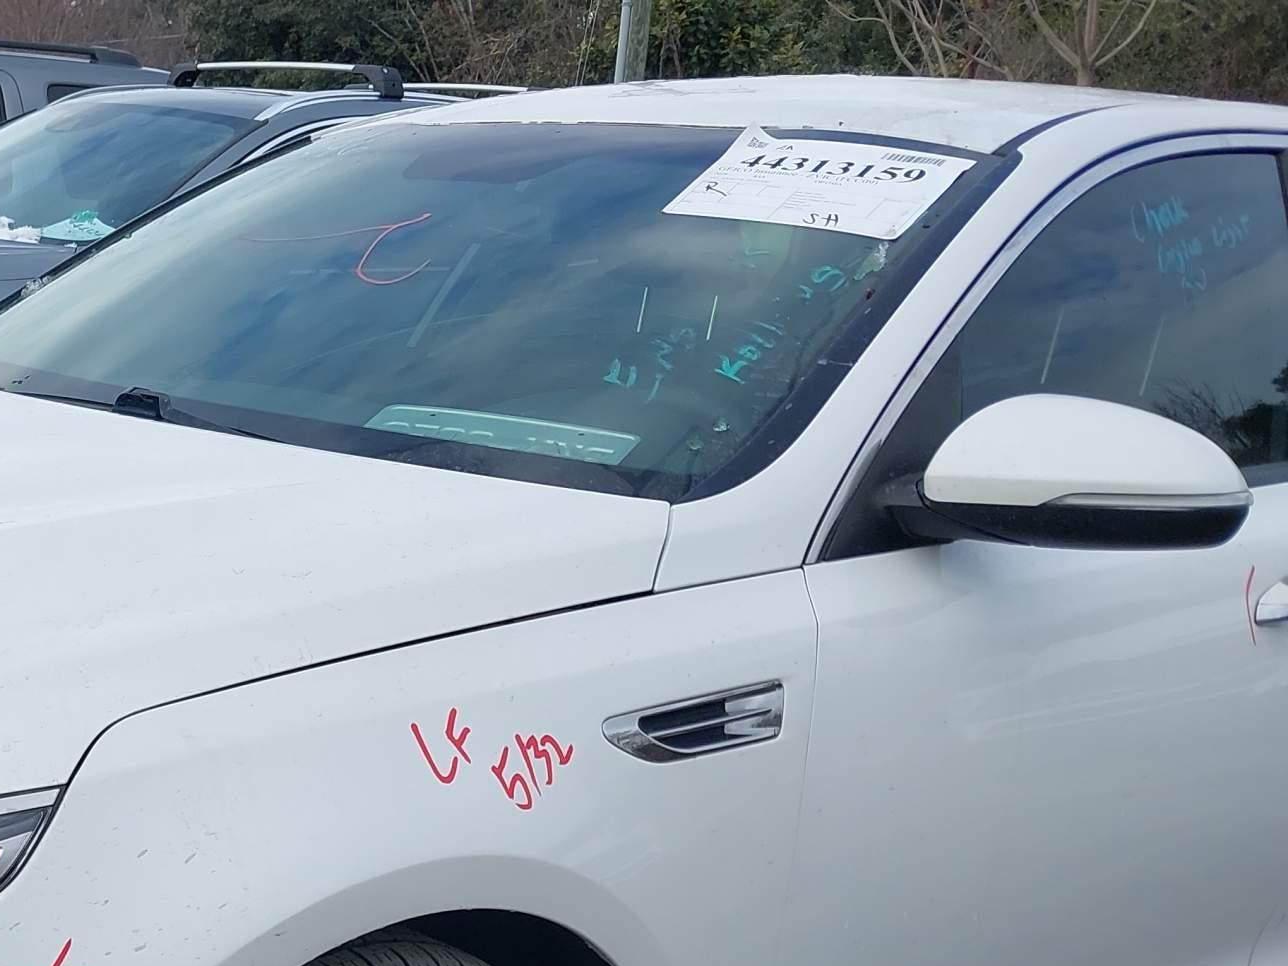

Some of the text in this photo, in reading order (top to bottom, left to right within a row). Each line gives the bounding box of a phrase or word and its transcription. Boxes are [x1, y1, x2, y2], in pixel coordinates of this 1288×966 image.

[740, 155, 926, 183] 44313159
[411, 707, 472, 785] LF
[491, 734, 574, 810] 5/32
